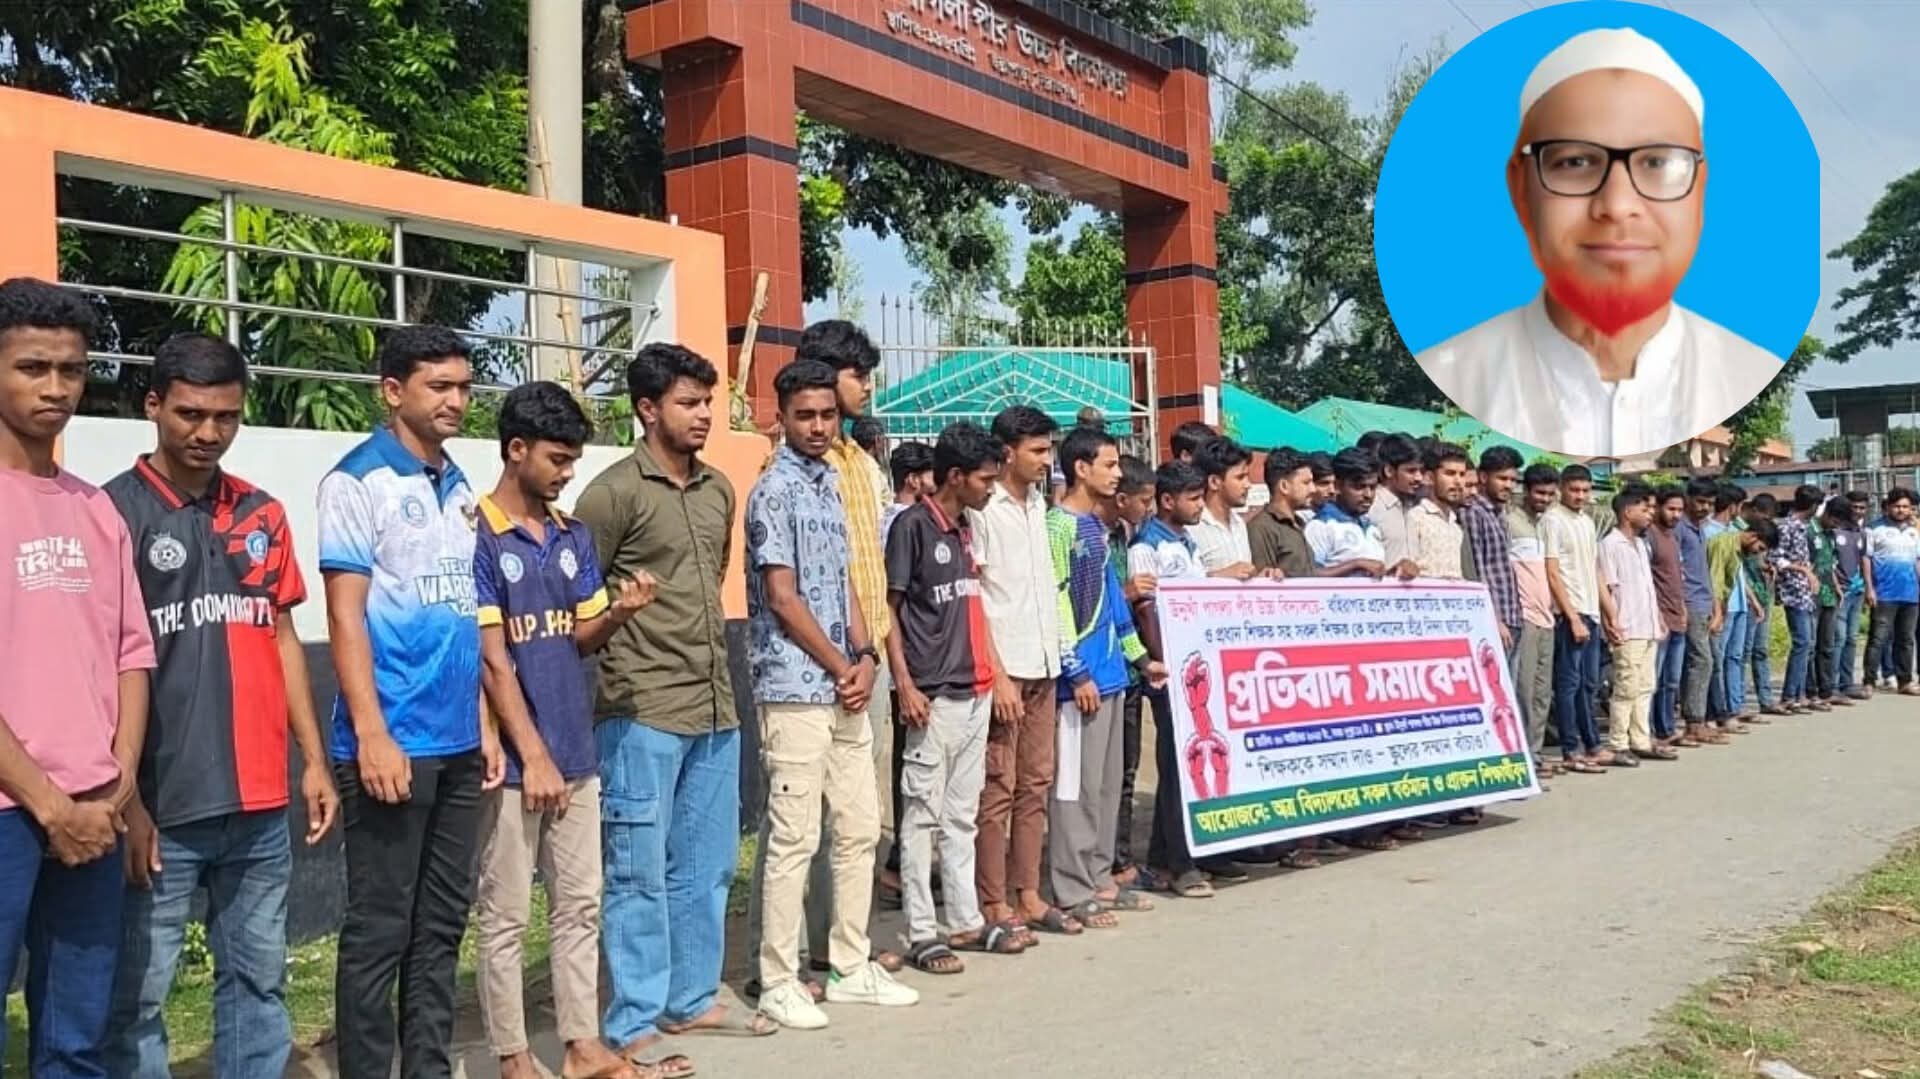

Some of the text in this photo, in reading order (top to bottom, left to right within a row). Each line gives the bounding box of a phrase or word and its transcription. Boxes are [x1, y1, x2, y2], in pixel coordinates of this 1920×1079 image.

[414, 574, 477, 607] WARR
[151, 602, 185, 637] THE
[1243, 619, 1275, 643] শিক্ষক
[1227, 651, 1479, 723] প্রতিবাদ সমাবেশ
[1271, 797, 1297, 819] অত্র
[1296, 788, 1361, 817] বিদ্যালয়ের
[1361, 782, 1391, 805] সকল
[1391, 772, 1431, 799] বর্তমান
[1432, 776, 1445, 792] ও
[1445, 769, 1479, 792] প্রাক্তন
